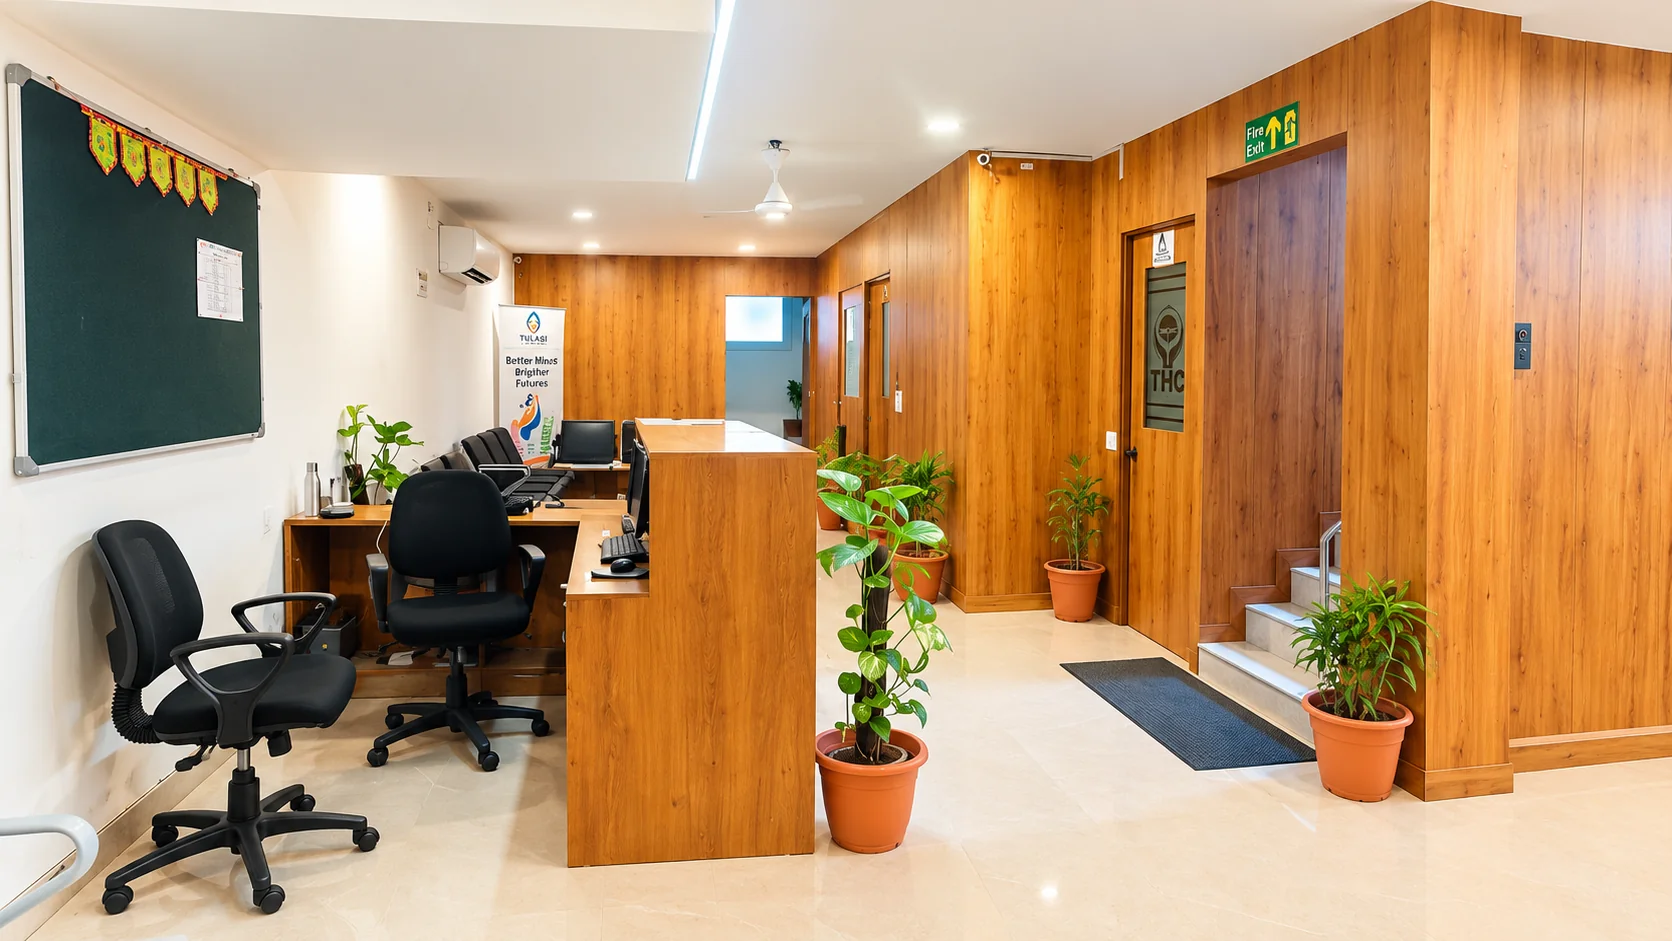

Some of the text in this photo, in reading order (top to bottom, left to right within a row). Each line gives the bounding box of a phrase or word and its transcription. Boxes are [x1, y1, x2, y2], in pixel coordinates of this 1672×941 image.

[1247, 126, 1264, 141] Fire
[1247, 141, 1265, 158] Exit
[519, 334, 548, 343] TULASI
[505, 356, 533, 365] Better
[515, 379, 549, 388] Futures
[1150, 369, 1185, 393] THC
